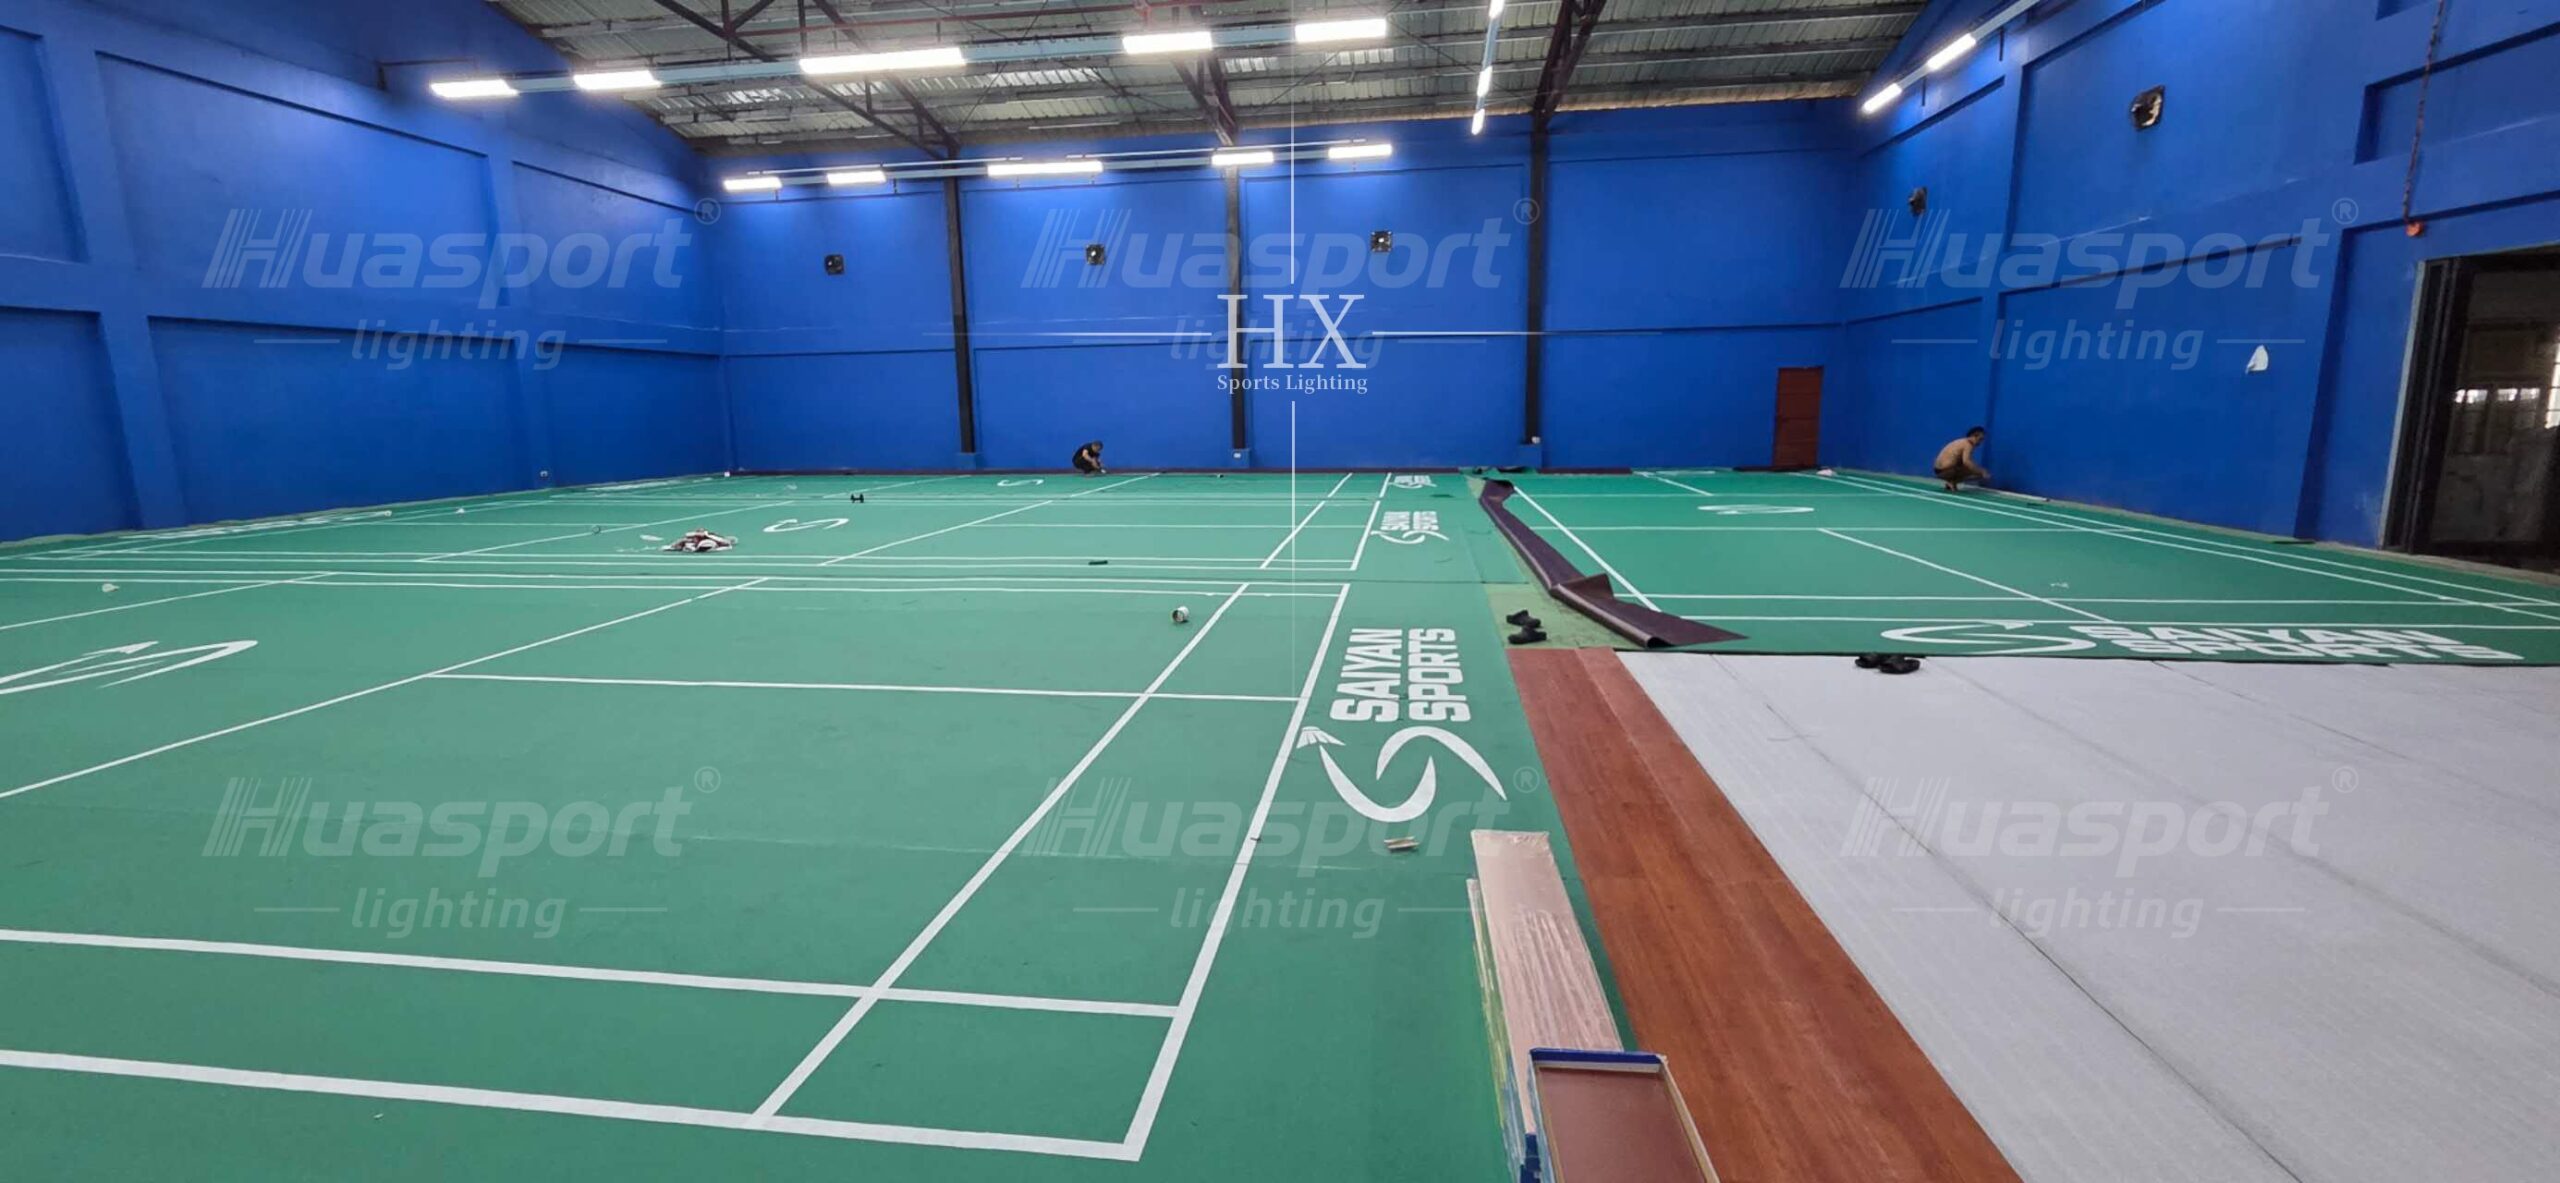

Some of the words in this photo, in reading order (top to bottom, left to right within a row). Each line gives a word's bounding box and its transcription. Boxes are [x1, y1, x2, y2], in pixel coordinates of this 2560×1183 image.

[2069, 626, 2465, 644] SAIYAN
[2111, 640, 2525, 660] SPORTS
[1329, 628, 1403, 723] SAIYAN
[1408, 628, 1472, 723] SPORTS
